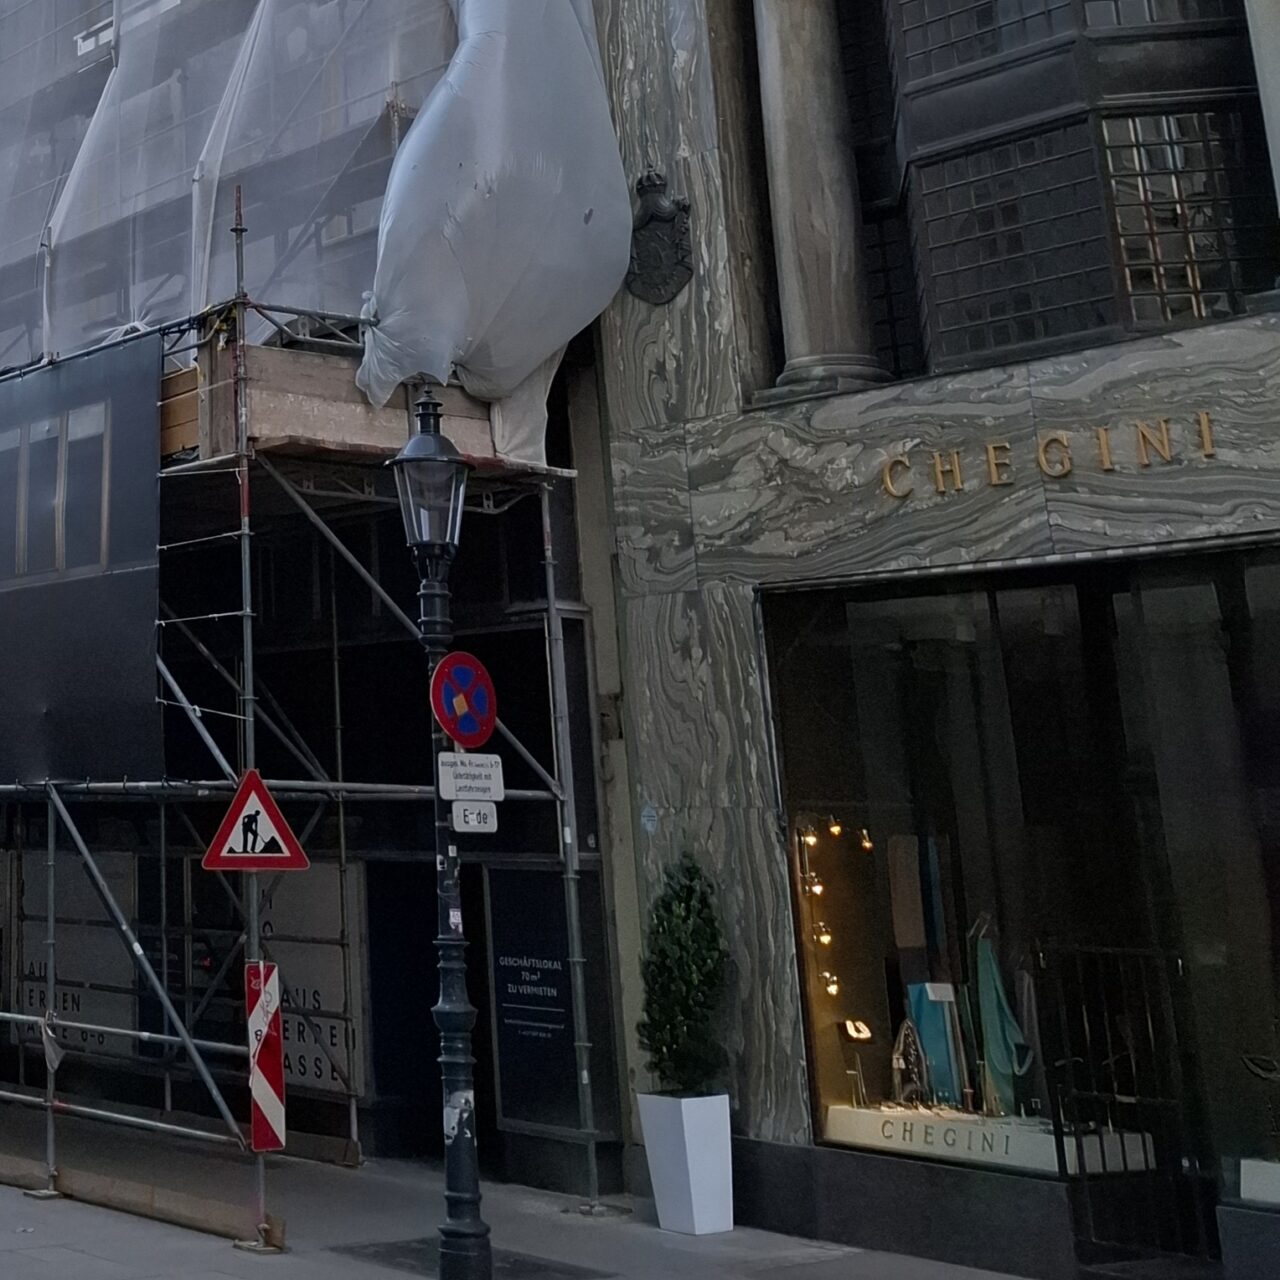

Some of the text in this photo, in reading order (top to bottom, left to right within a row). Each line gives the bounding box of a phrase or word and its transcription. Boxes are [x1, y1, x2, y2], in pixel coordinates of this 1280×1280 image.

[882, 410, 1217, 499] CHEGINI
[463, 808, 488, 825] Ede
[499, 955, 562, 971] GESCHÄFTSLOKAL
[282, 989, 321, 1010] AUS
[507, 983, 557, 998] ZU VERMIETEN
[881, 1119, 1010, 1155] CHEGINI
